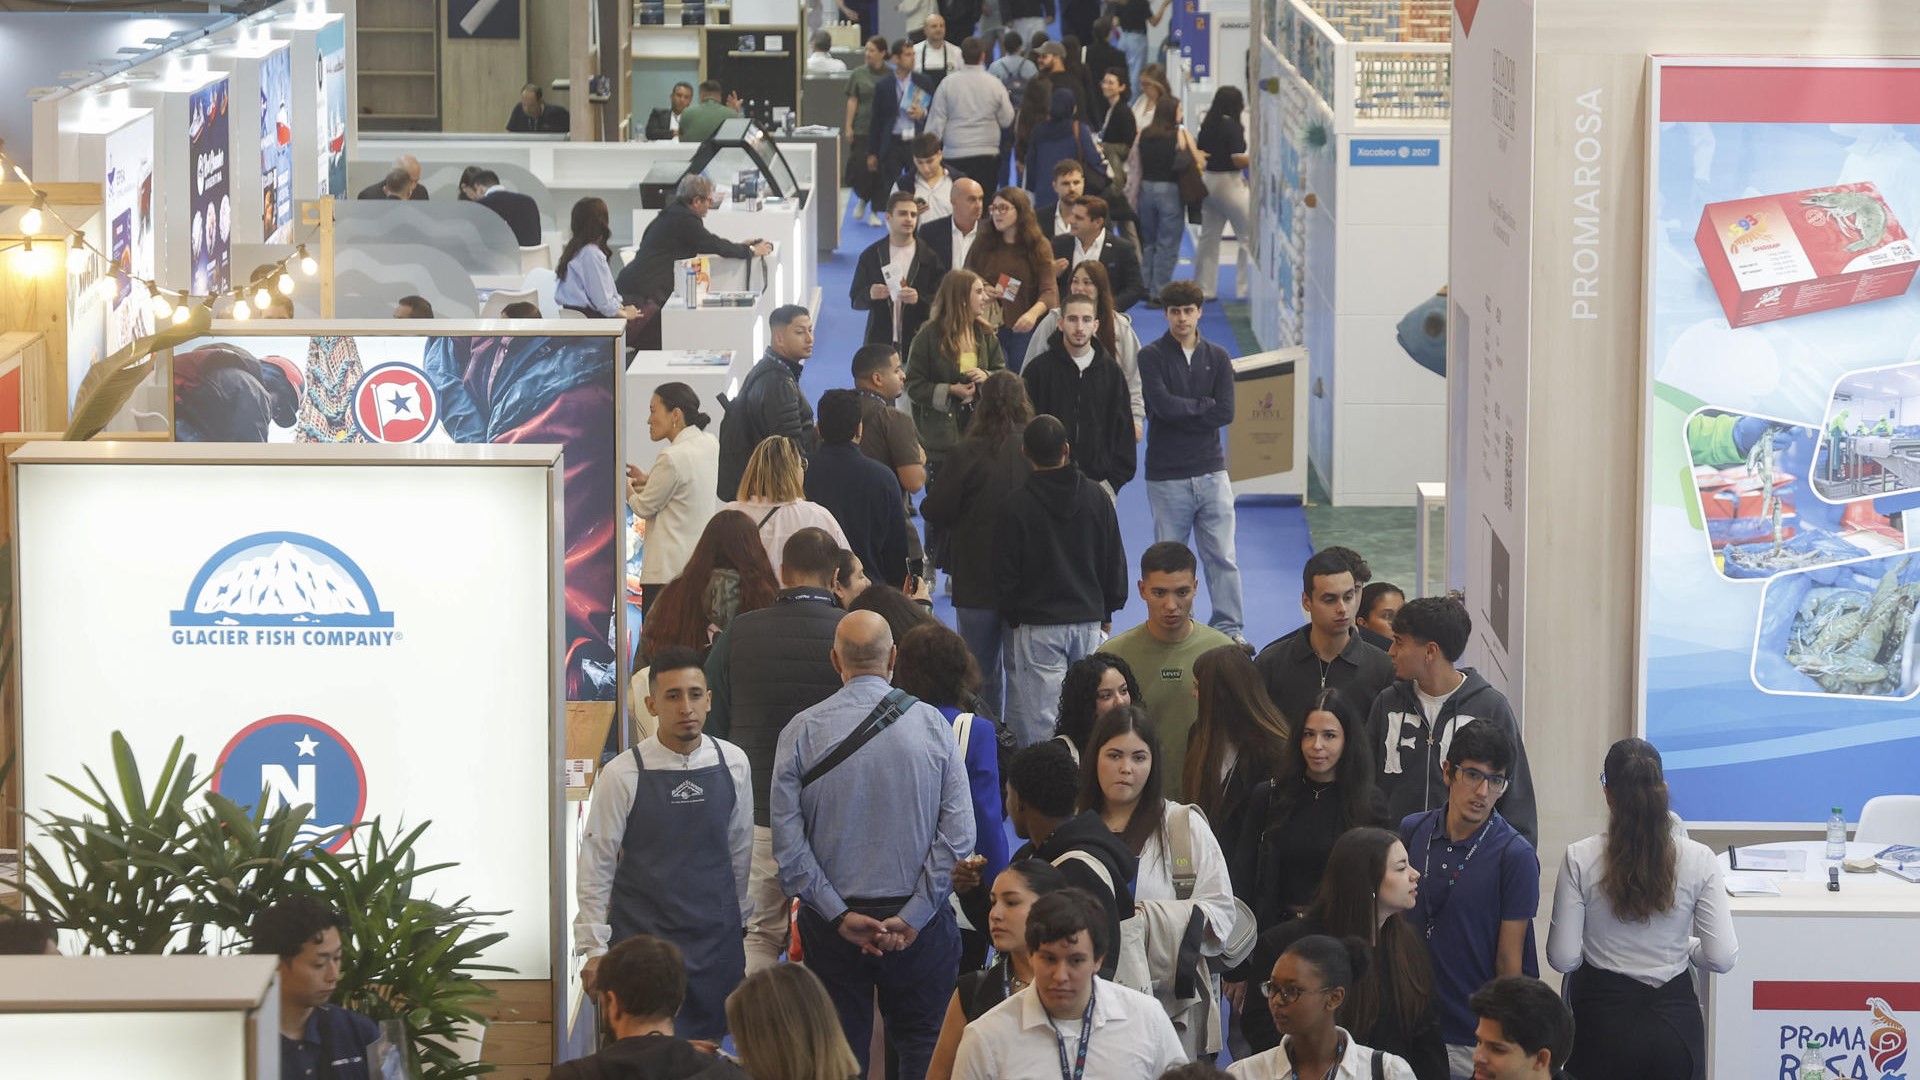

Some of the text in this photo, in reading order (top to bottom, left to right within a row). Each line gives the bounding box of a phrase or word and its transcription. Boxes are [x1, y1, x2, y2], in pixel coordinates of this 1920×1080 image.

[1411, 148, 1431, 157] 2027
[1571, 88, 1603, 321] PROMAROSA
[1728, 214, 1759, 237] 593
[172, 629, 249, 646] GLACIER
[256, 629, 296, 646] FISH
[1779, 1054, 1869, 1080] RSA
